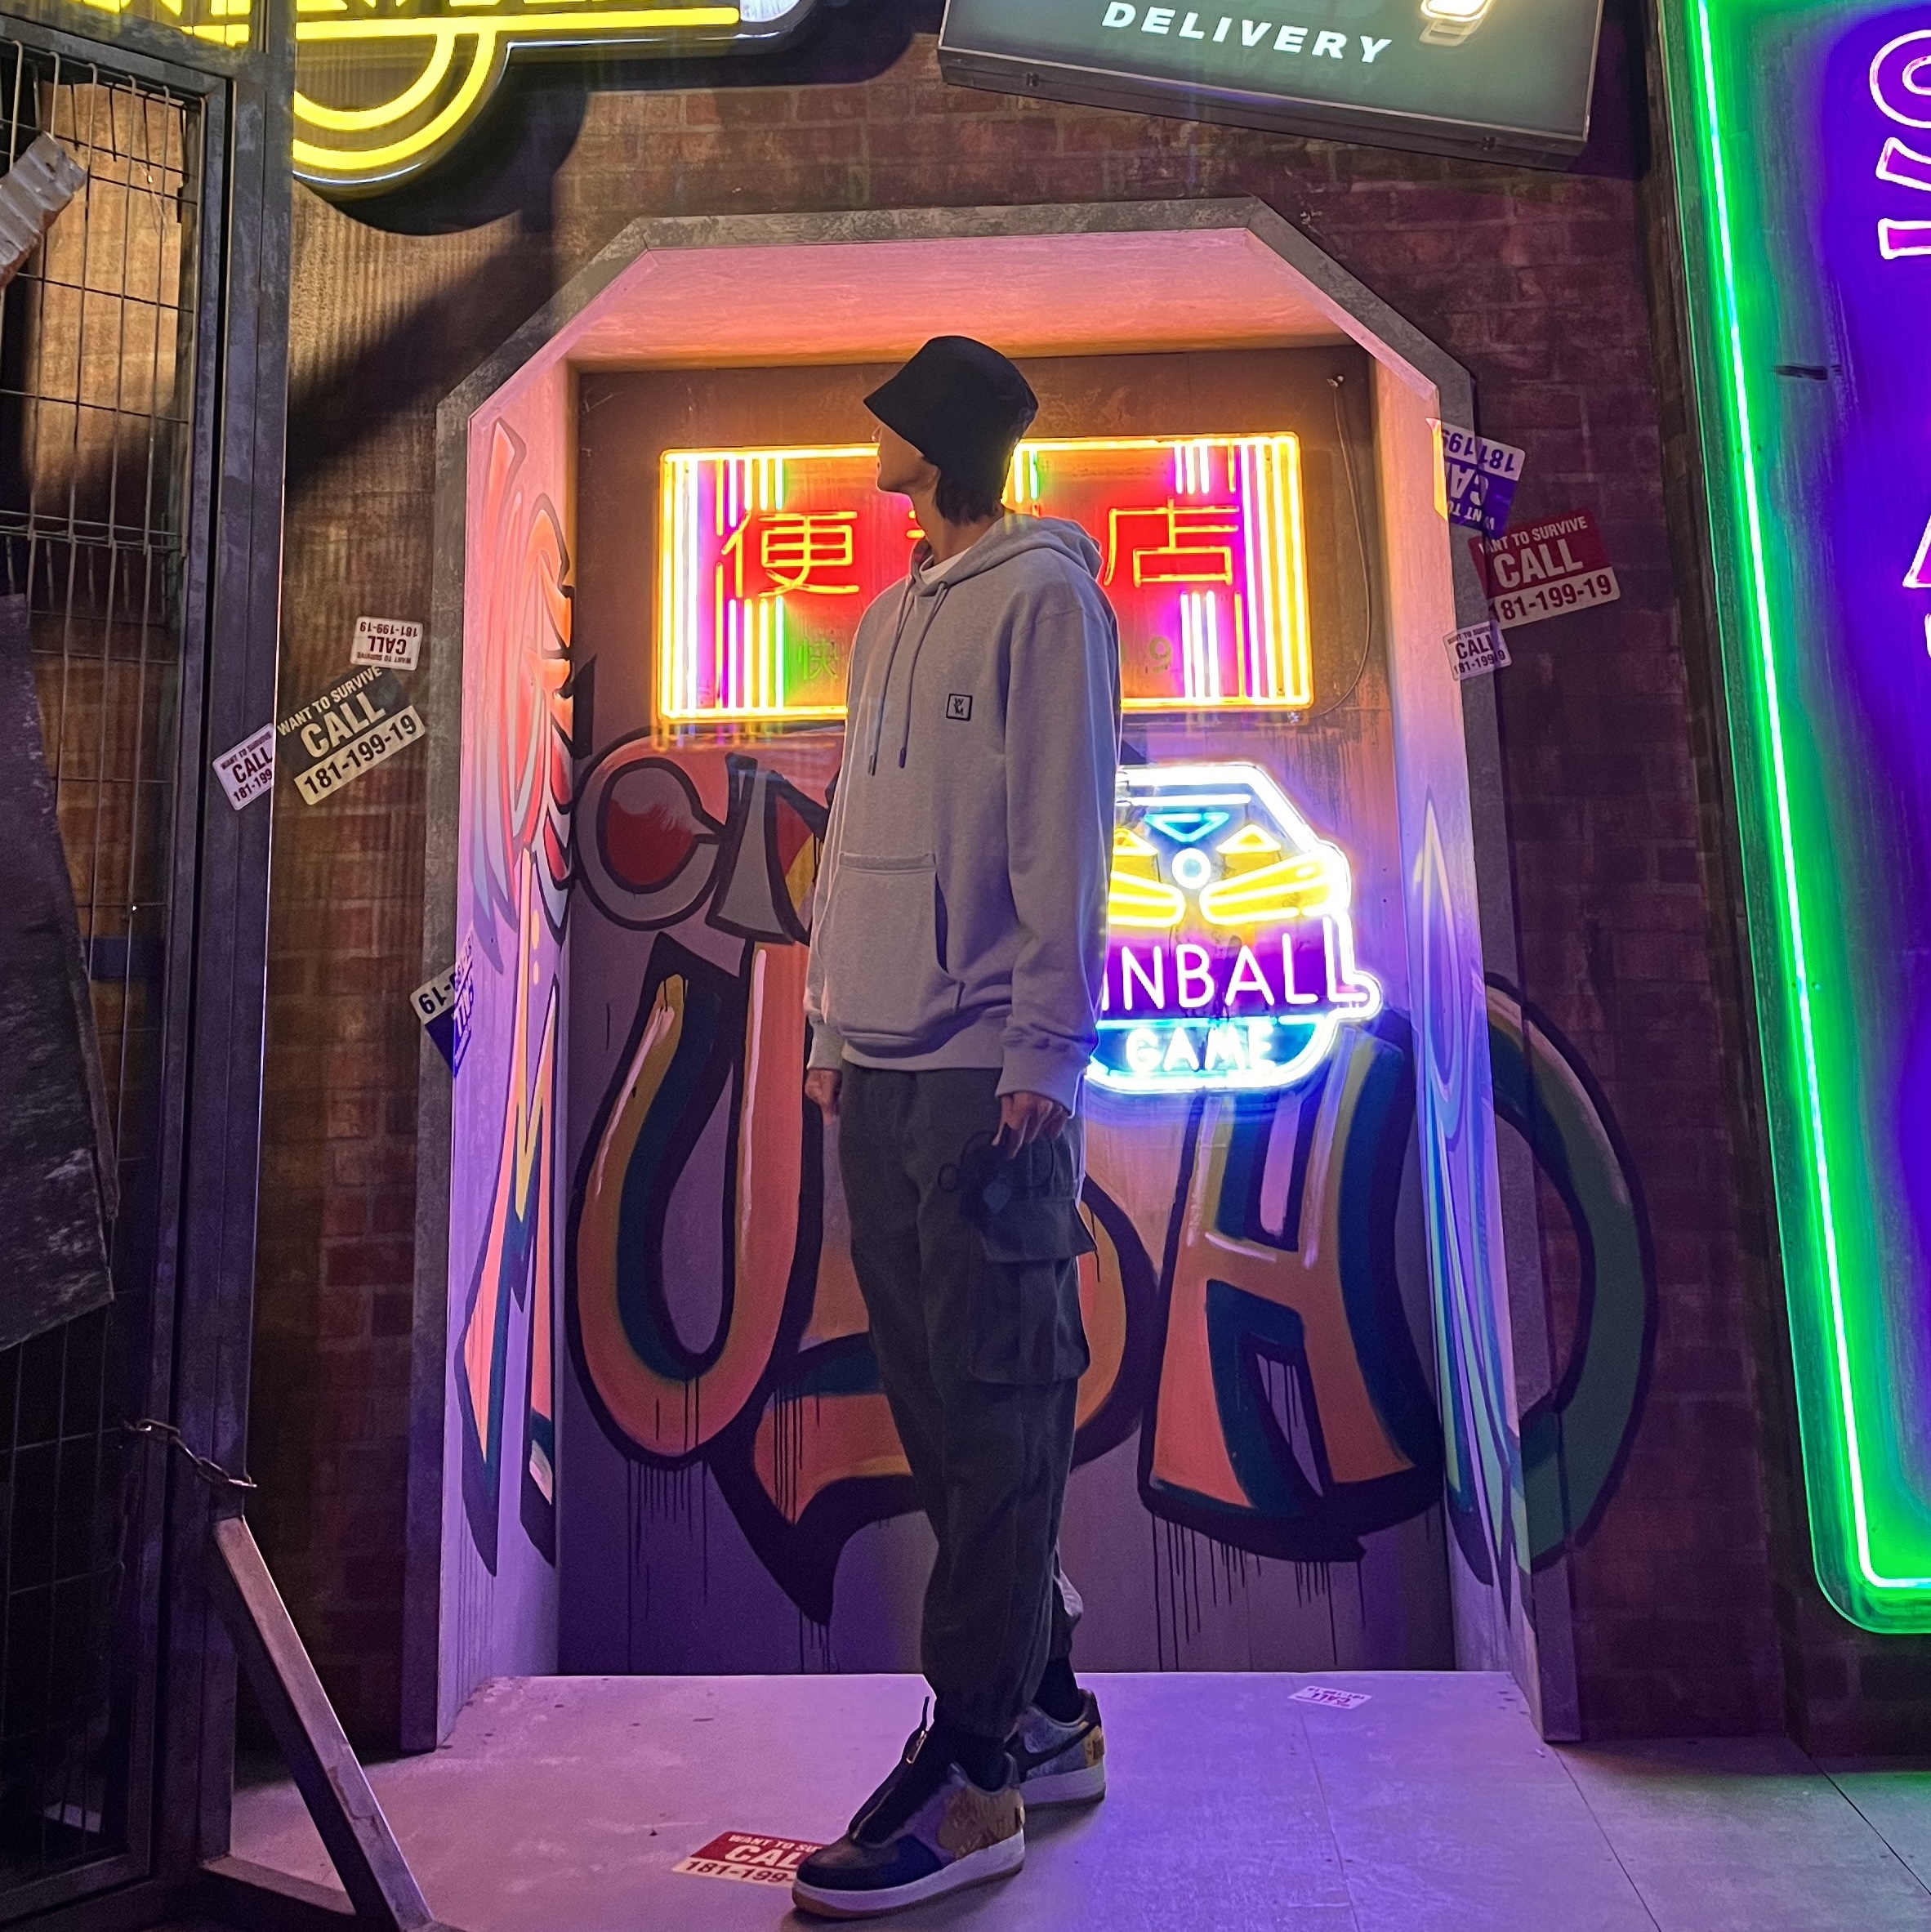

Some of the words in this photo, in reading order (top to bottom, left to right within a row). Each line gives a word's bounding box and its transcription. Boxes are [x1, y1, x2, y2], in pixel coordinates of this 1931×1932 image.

[1101, 1, 1392, 64] DELIVERY
[1446, 462, 1488, 506] CA
[1511, 531, 1529, 546] TO
[1532, 516, 1588, 542] SURVIVE
[1493, 538, 1583, 588] CALL
[359, 621, 417, 637] 181-199-19
[368, 636, 407, 655] CALL
[277, 707, 312, 735] WANT
[312, 696, 331, 713] TO
[330, 665, 382, 703] SURVIVE
[301, 691, 386, 758] CALL
[232, 747, 273, 783] CALL
[304, 714, 417, 795] 181-199-19
[233, 769, 272, 801] 181-199
[1102, 915, 1368, 1011] INBALL
[1125, 1021, 1277, 1074] GAME
[725, 1845, 801, 1869] CAL
[728, 1835, 774, 1846] WANT
[774, 1841, 796, 1849] TO
[686, 1861, 794, 1882] 181-199-
